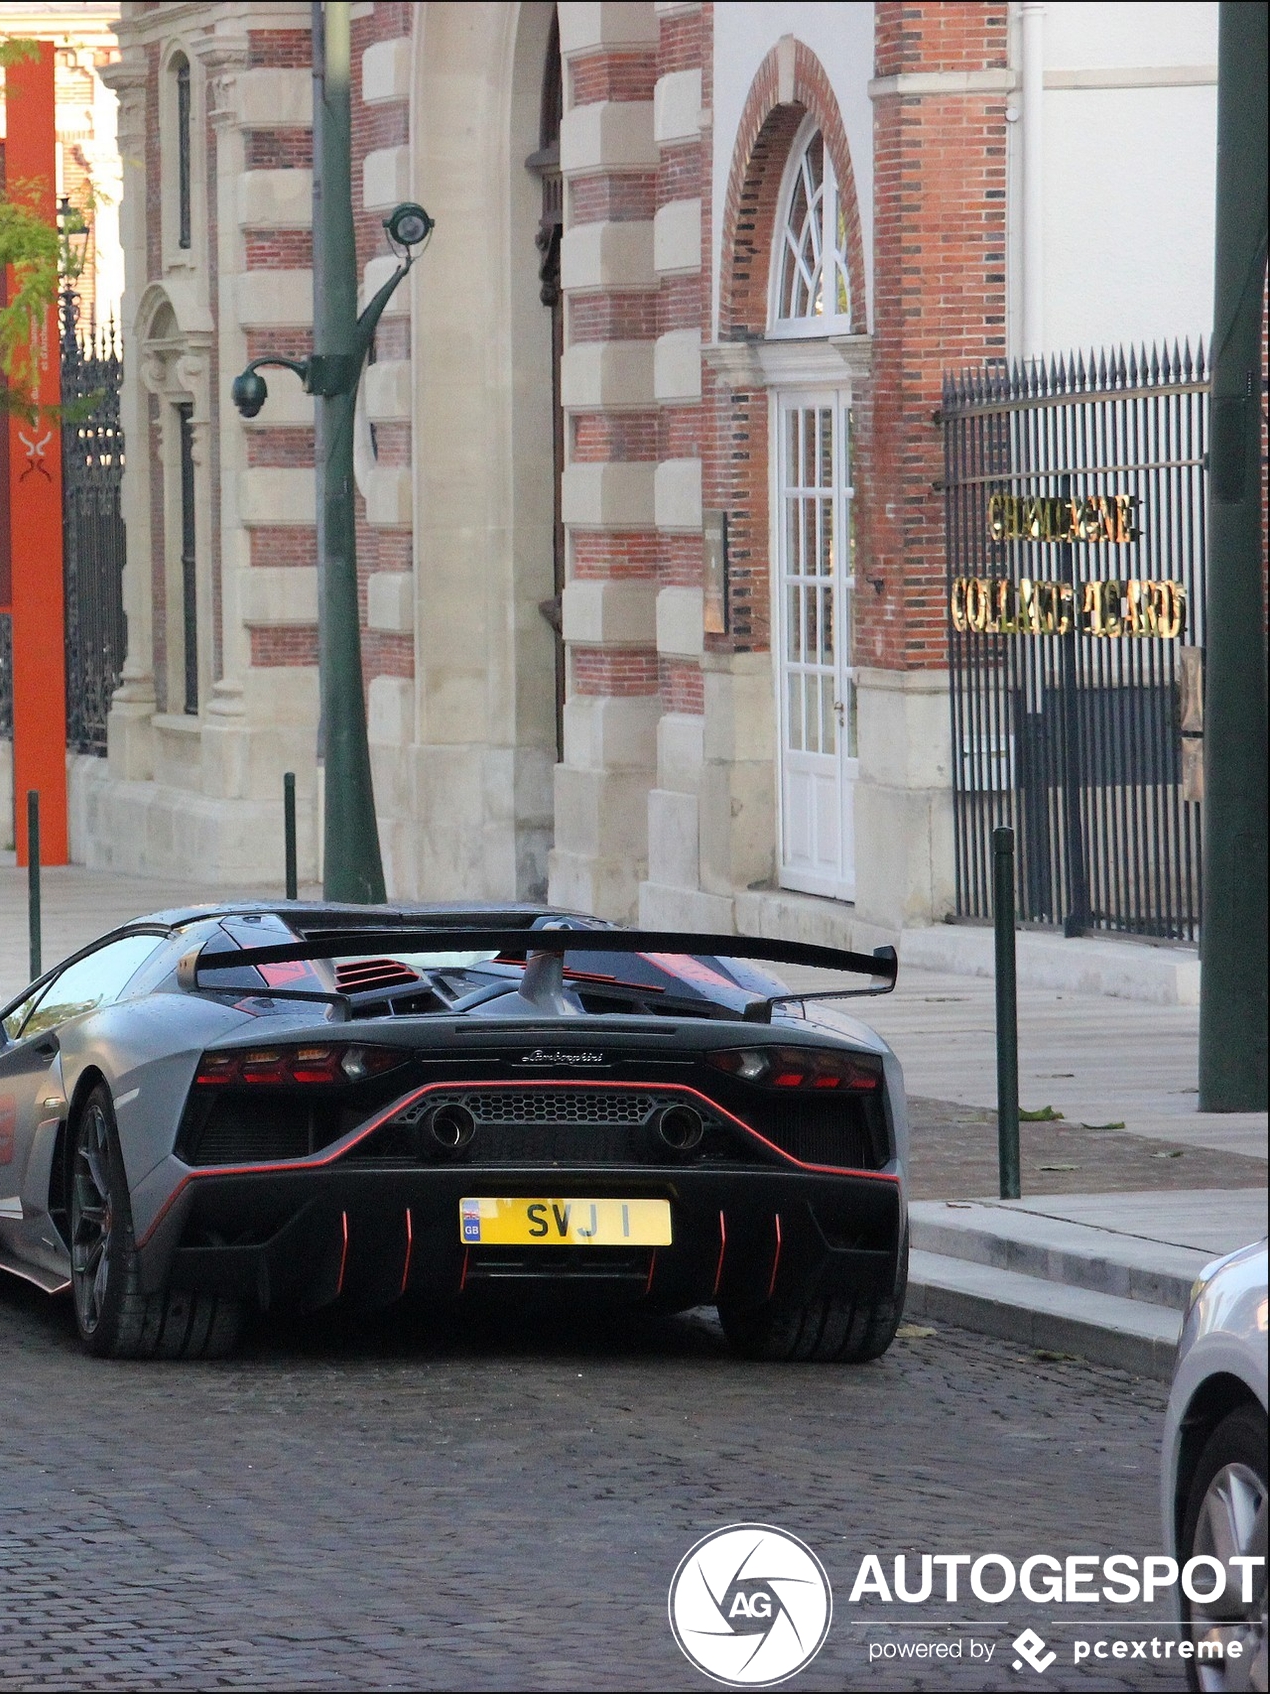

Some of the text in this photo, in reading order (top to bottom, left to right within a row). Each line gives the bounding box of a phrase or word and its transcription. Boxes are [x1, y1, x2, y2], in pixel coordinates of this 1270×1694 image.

[521, 1049, 603, 1065] Lamborghini
[526, 1204, 597, 1237] SVJ
[465, 1226, 479, 1235] GB
